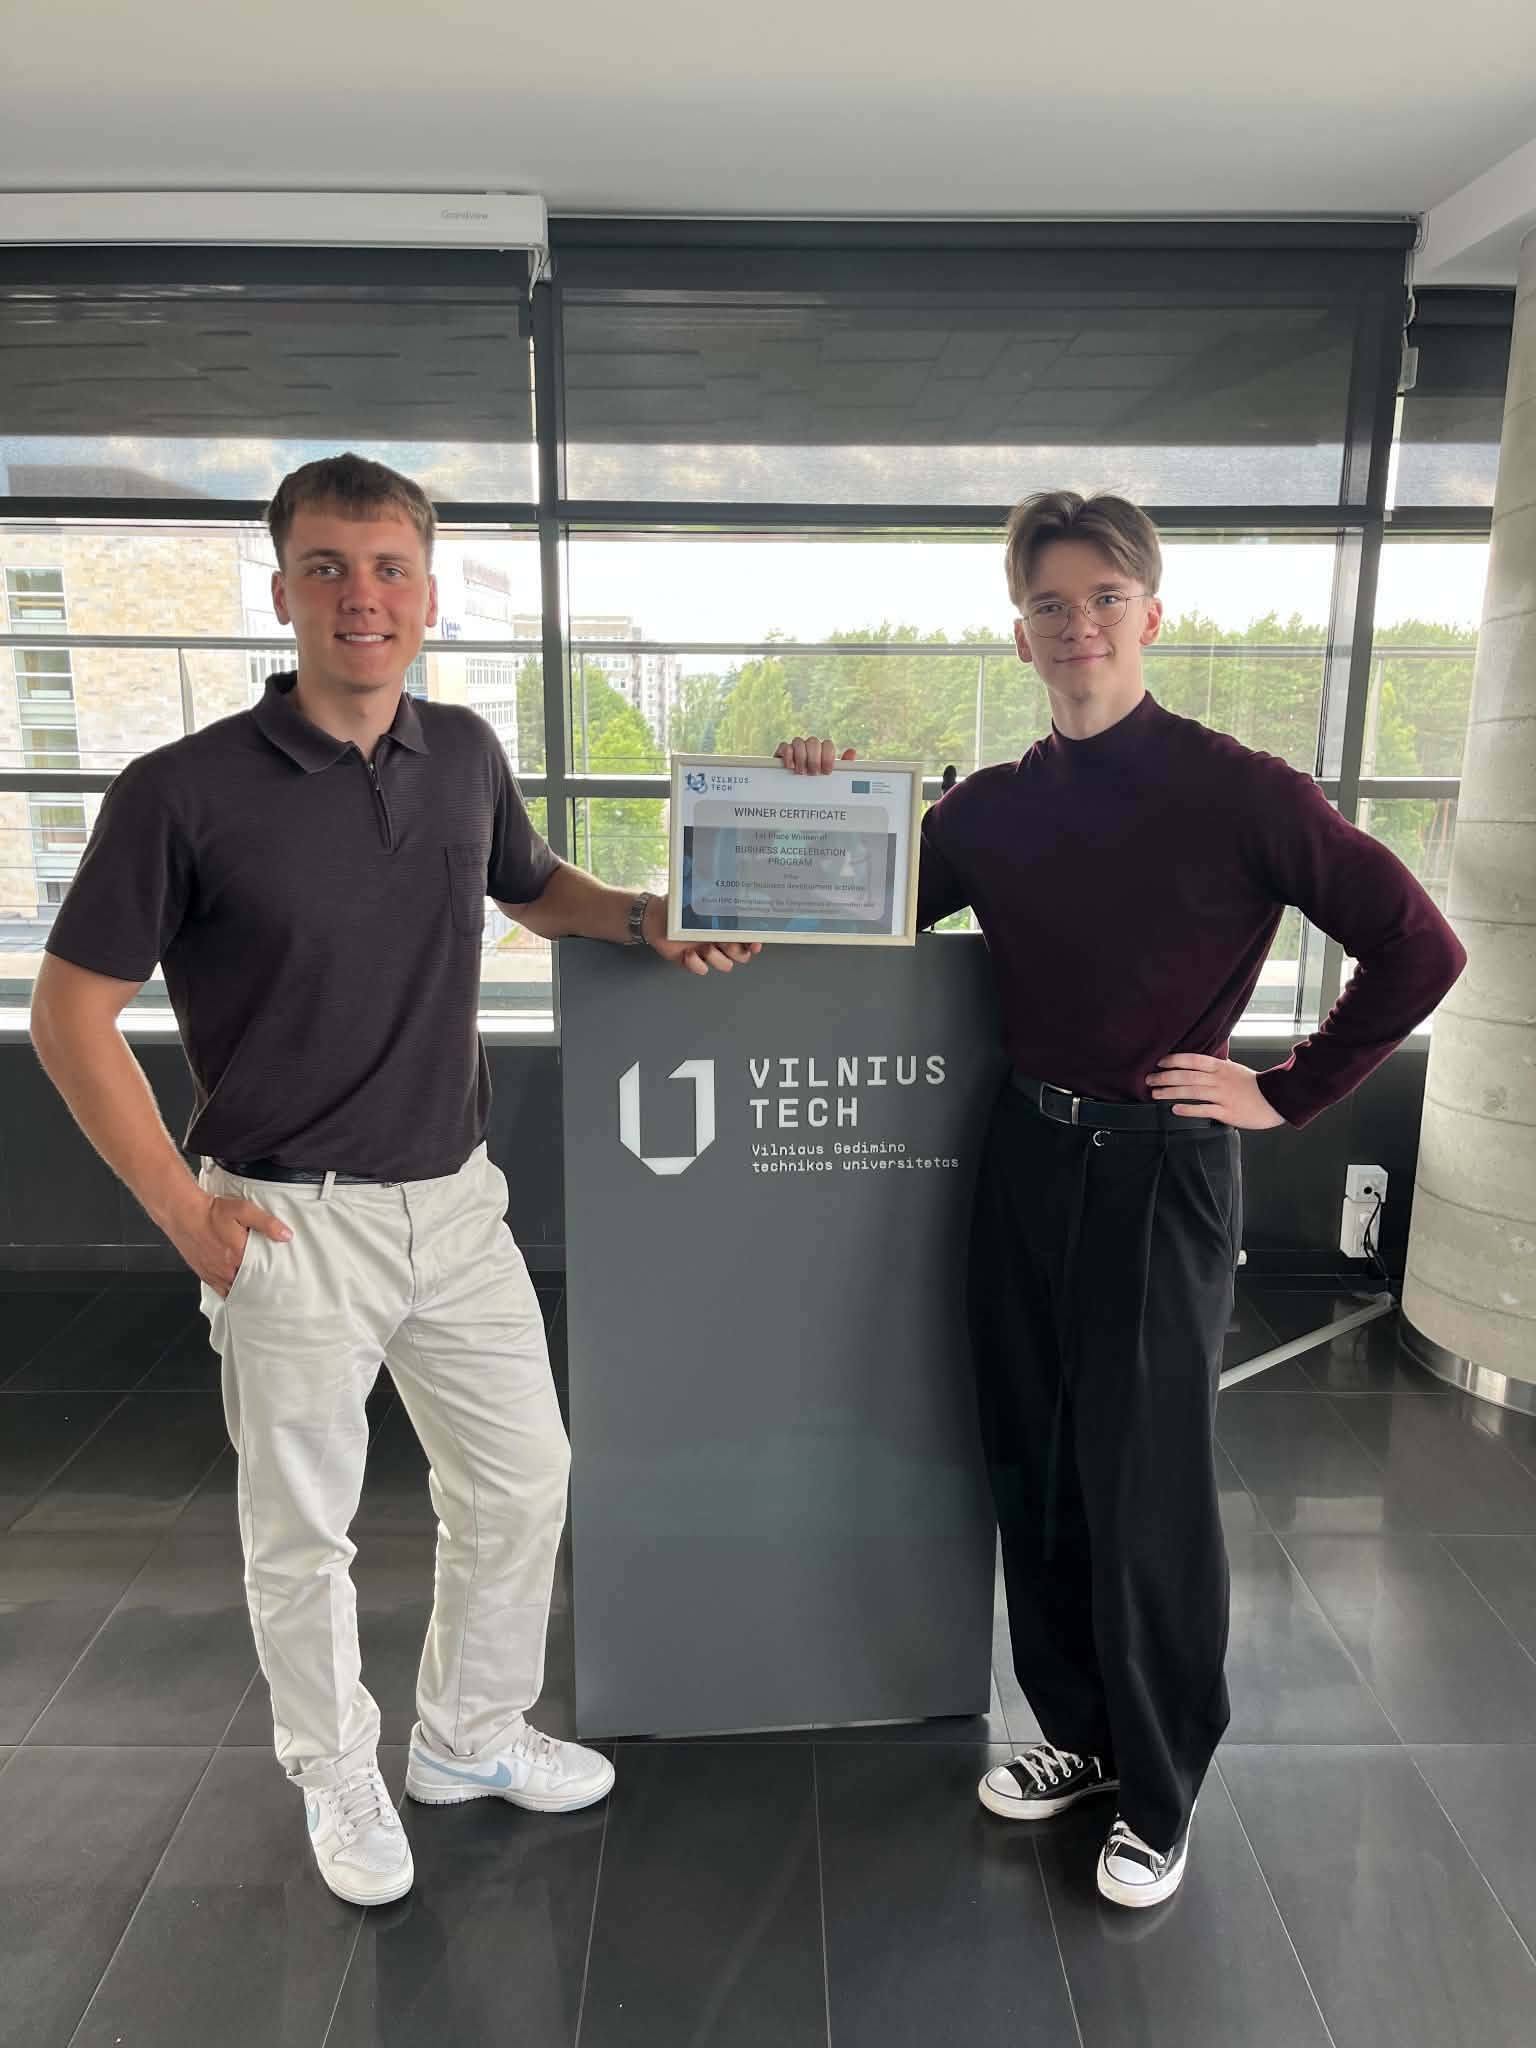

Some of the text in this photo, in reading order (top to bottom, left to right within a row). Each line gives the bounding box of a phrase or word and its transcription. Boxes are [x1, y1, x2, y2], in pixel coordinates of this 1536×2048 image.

[711, 776, 751, 784] VILNIUS
[711, 784, 733, 792] TECH
[734, 807, 847, 821] WINNER CERTIFICATE
[735, 845, 778, 855] BUSINESS
[767, 858, 813, 866] PROGRAM
[749, 1055, 947, 1089] VILNIUS
[749, 1097, 859, 1129] TECH
[751, 1141, 906, 1157] Vilniaus Gedimino
[751, 1156, 960, 1174] technikos universitetas
